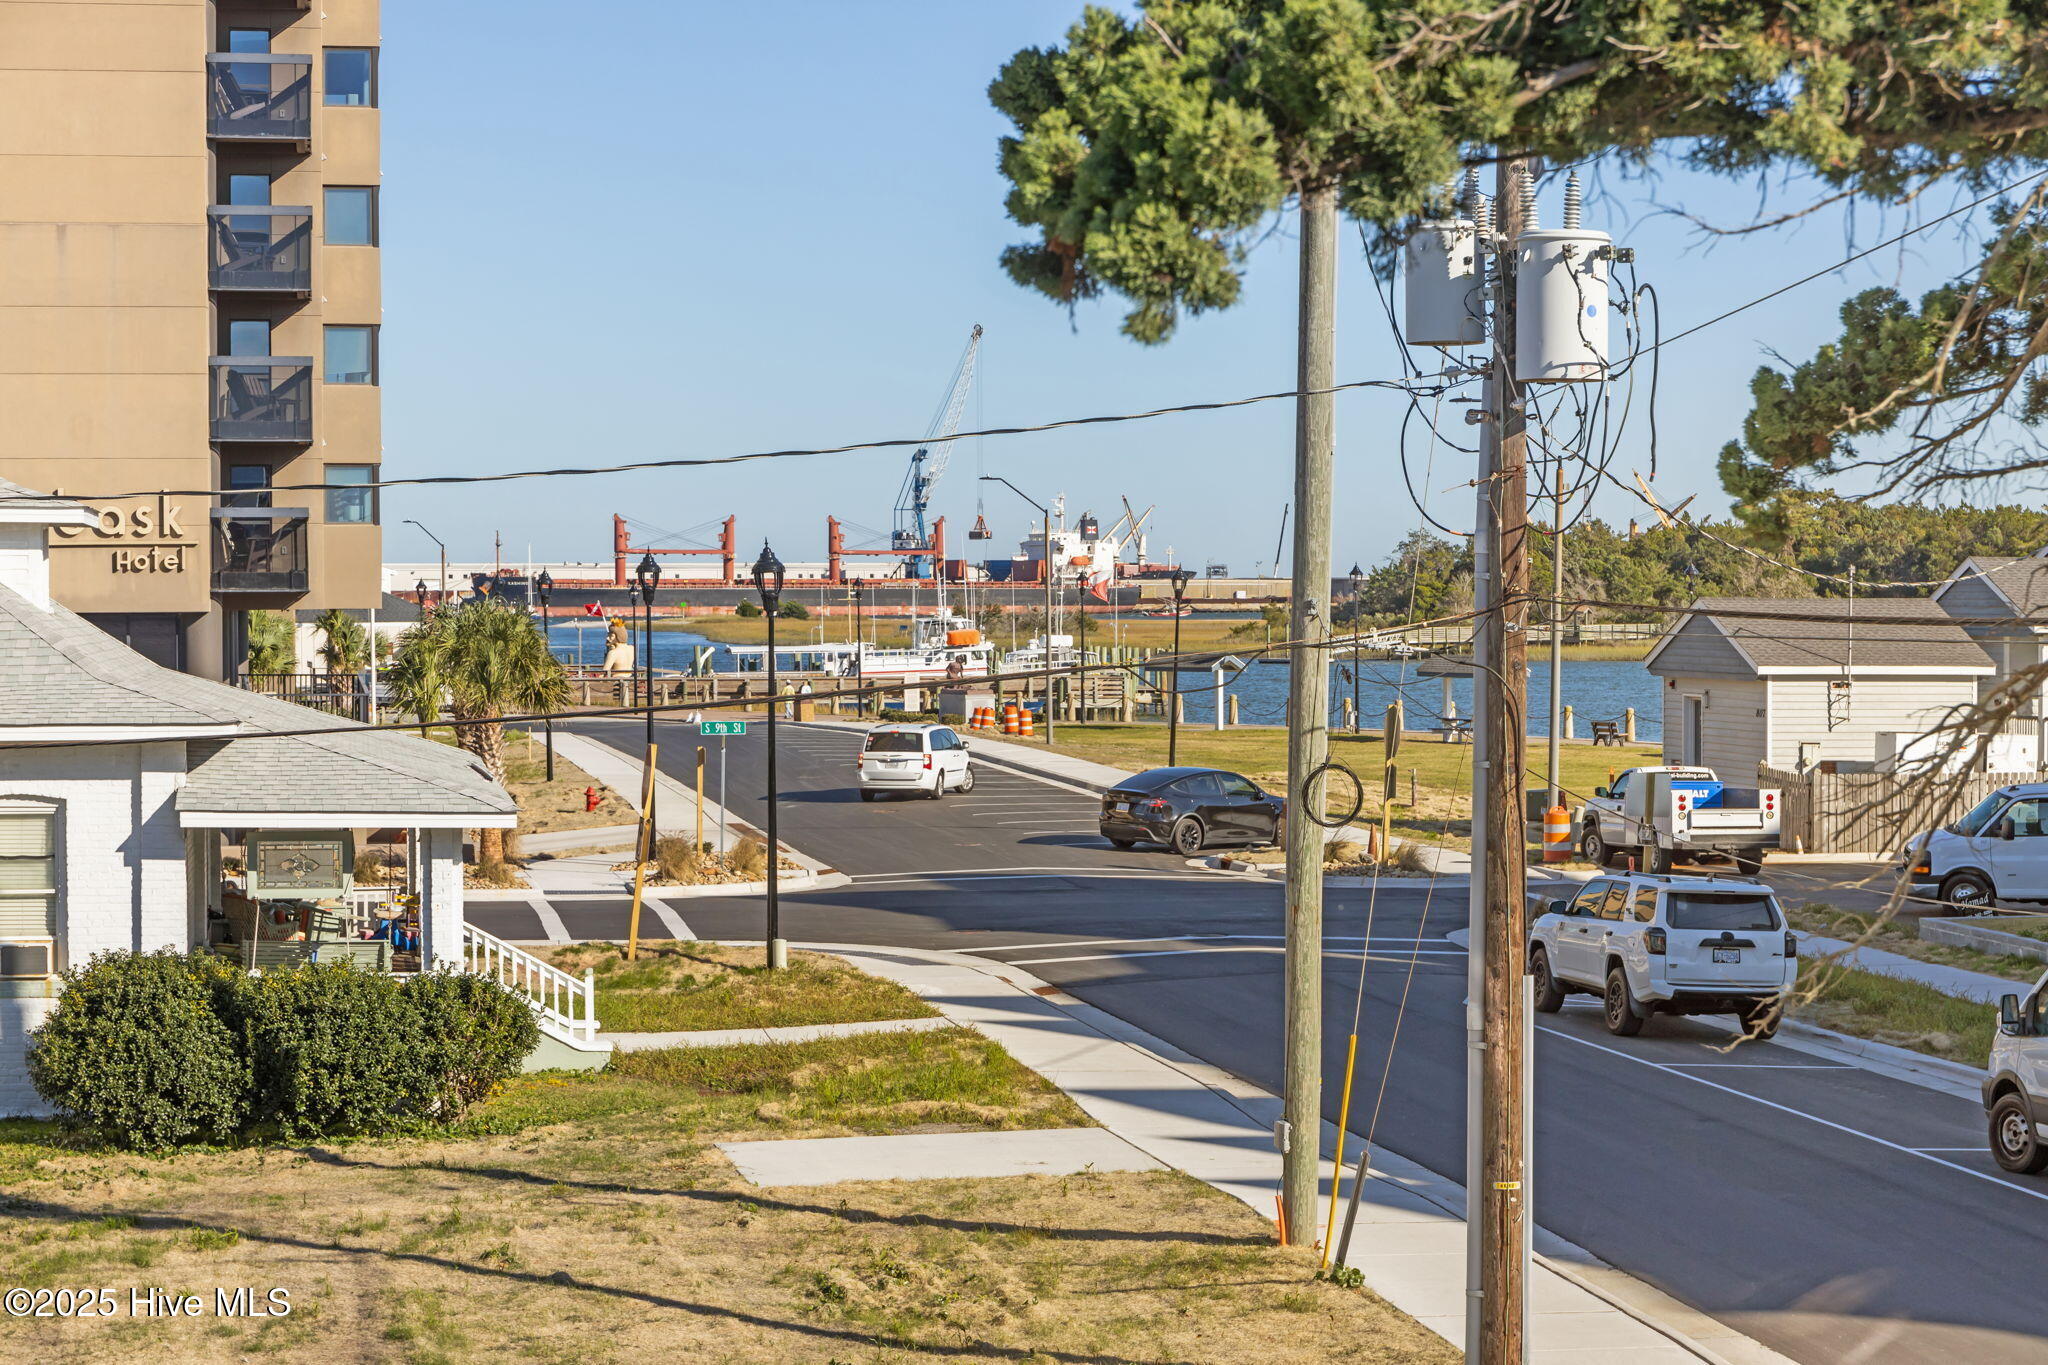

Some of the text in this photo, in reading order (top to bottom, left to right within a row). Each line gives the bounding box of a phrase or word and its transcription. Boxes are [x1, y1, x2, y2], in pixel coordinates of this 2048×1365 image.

[114, 545, 187, 572] Hotel
[705, 722, 742, 733] S 9th St
[1691, 789, 1709, 798] ALT
